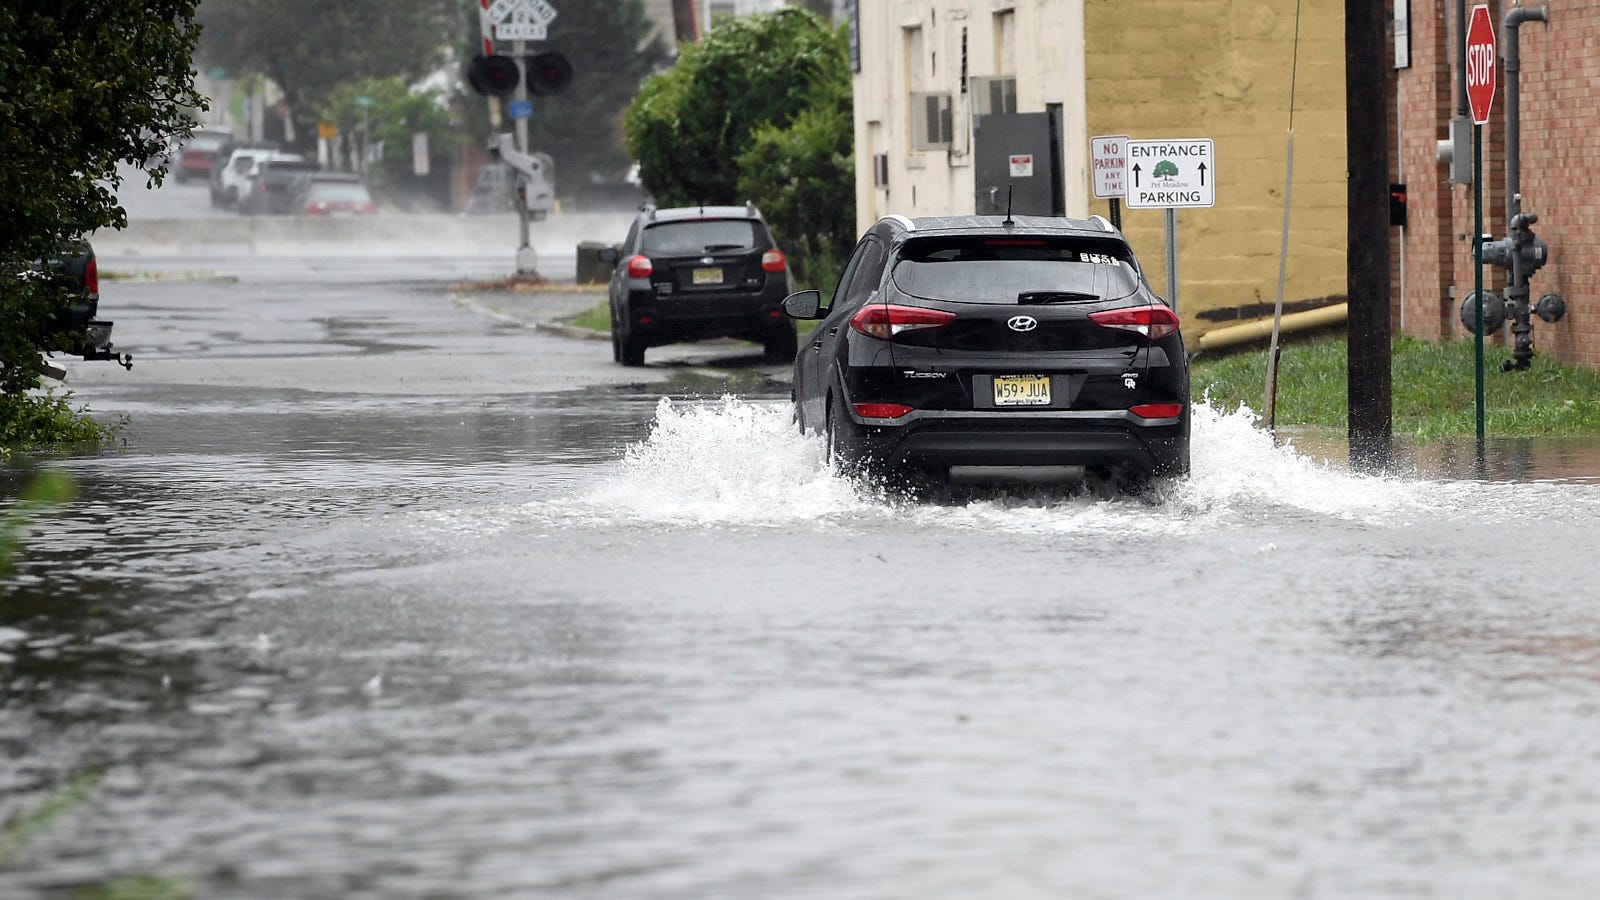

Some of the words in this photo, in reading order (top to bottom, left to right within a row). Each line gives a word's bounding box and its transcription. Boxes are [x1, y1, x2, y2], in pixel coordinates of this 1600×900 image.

[1468, 43, 1494, 87] STOP
[1103, 143, 1119, 155] NO
[1131, 145, 1207, 157] ENTRANCE
[1095, 157, 1125, 170] PARKIN
[1105, 172, 1121, 180] ANY
[1104, 182, 1123, 191] TIME
[1140, 191, 1201, 204] PARKING
[996, 383, 1017, 398] W59
[1026, 383, 1048, 397] JUA
